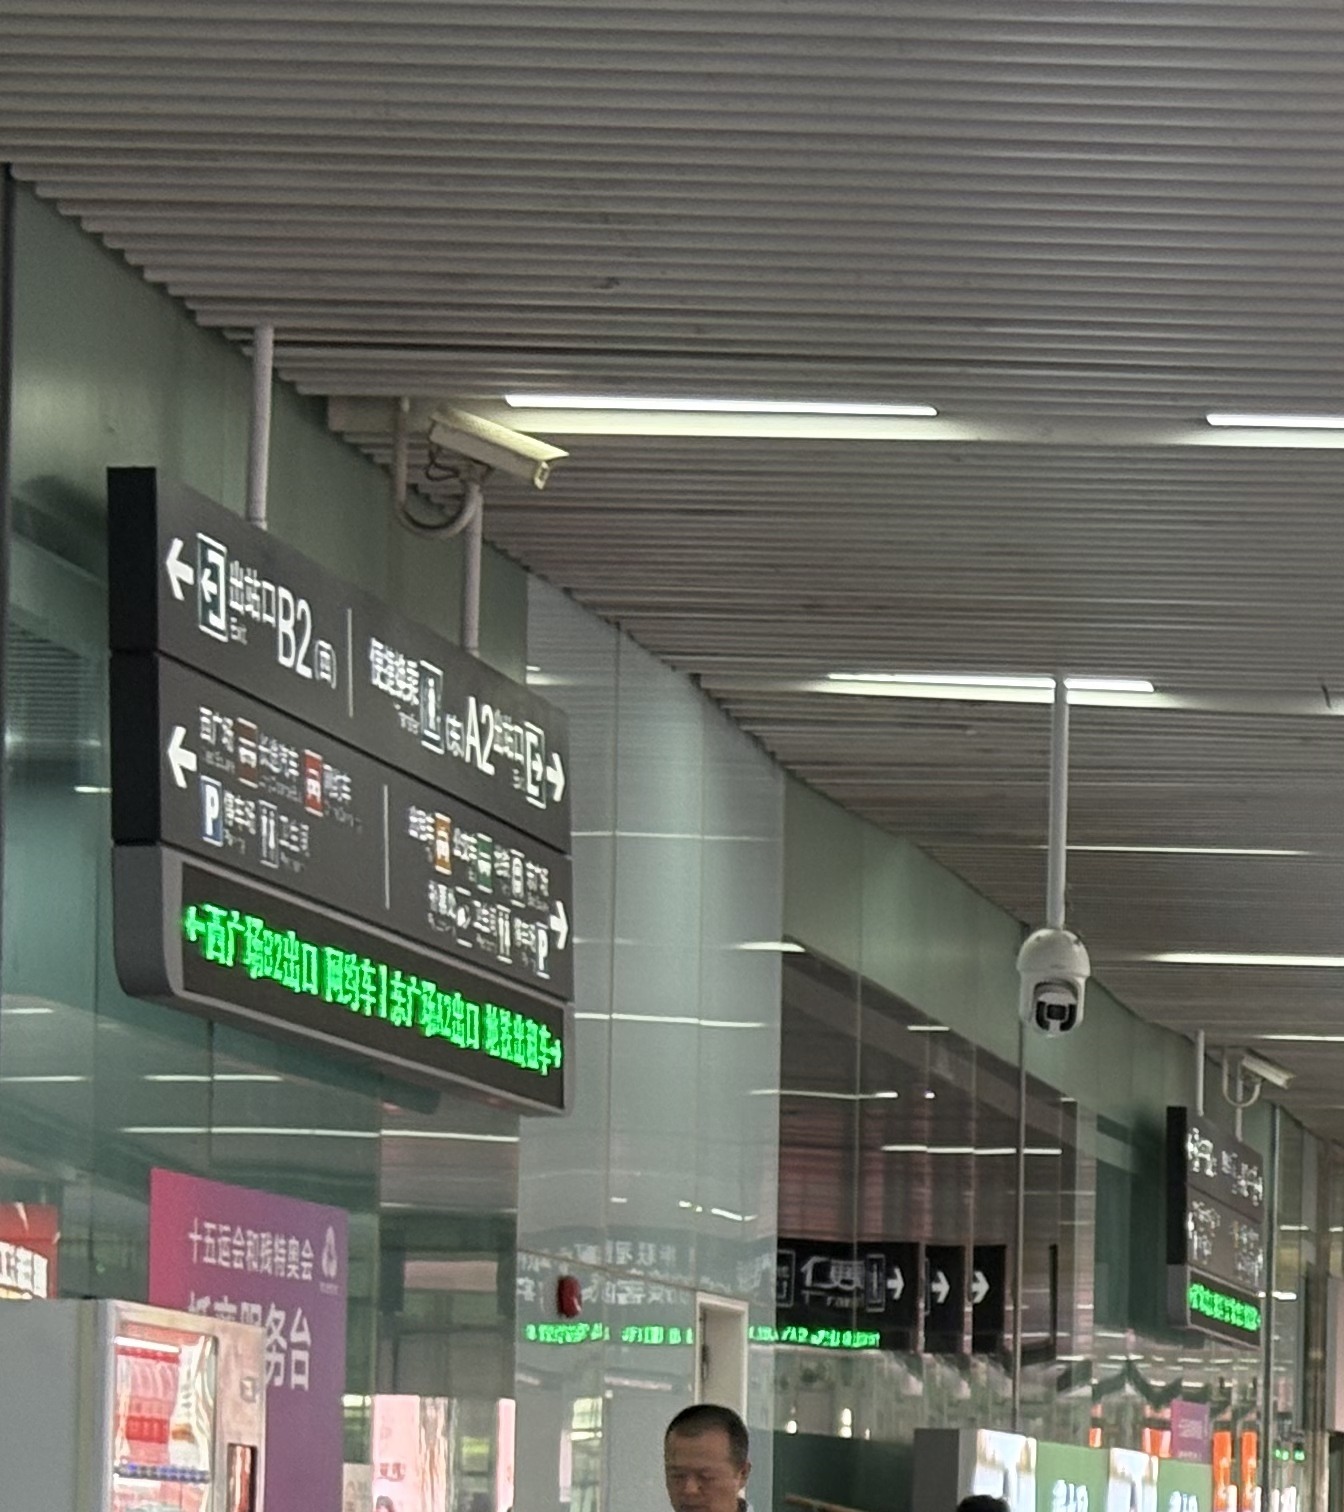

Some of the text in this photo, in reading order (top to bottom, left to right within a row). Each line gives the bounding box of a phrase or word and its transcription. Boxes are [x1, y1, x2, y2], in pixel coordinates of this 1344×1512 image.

[229, 560, 276, 628] 出站口
[278, 585, 313, 680] B2
[464, 696, 495, 775] A2
[188, 1216, 315, 1281] 十五运会和残特奥会
